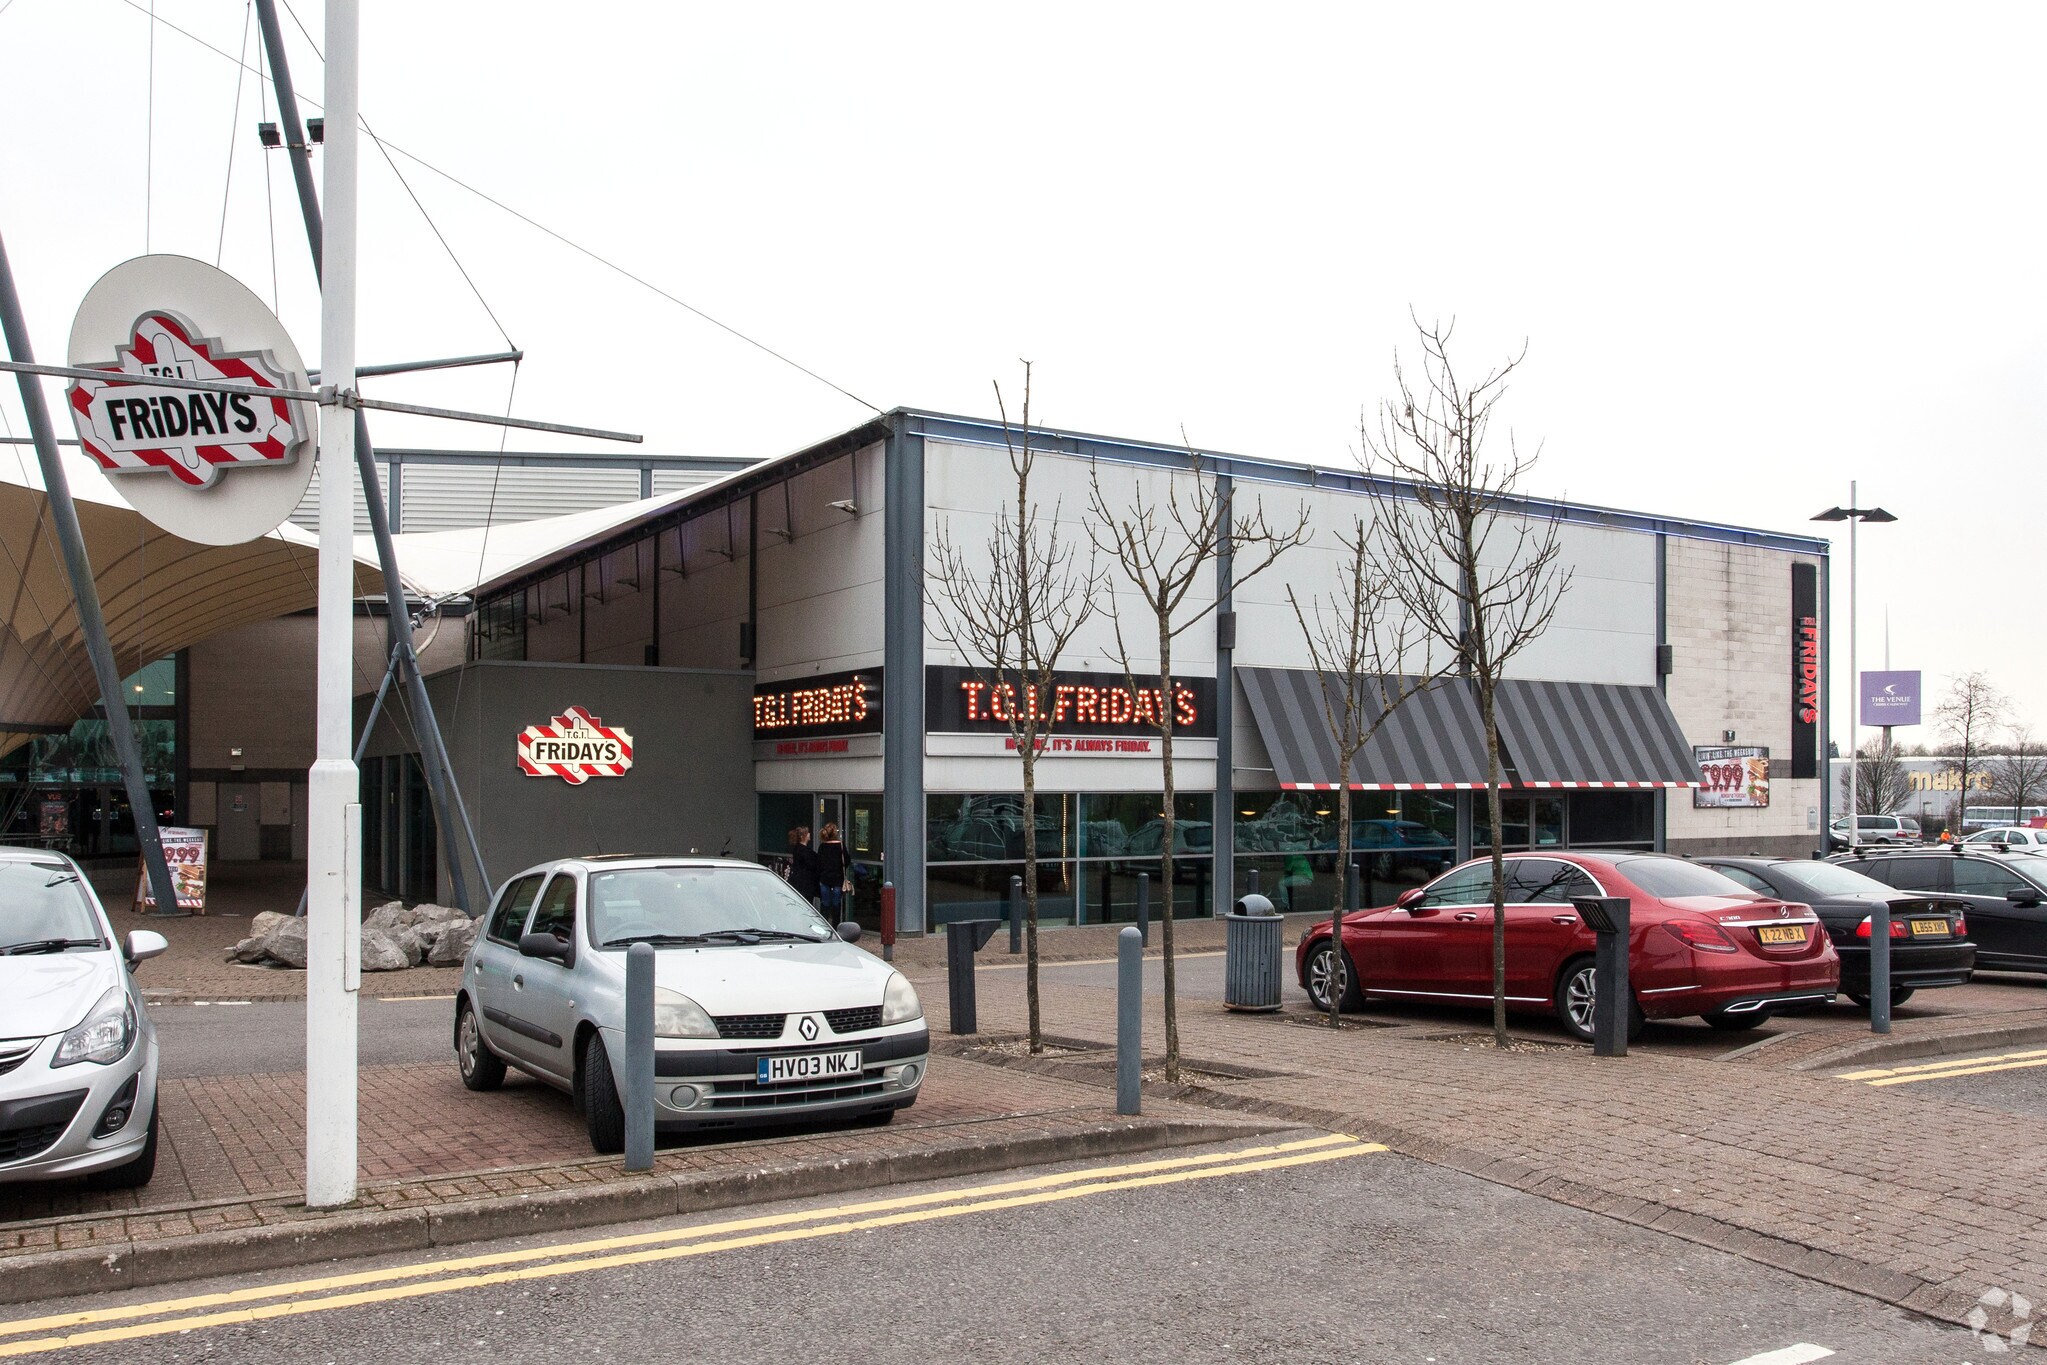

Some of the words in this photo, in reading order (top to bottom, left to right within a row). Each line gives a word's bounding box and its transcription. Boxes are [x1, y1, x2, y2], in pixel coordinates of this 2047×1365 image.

[1053, 739, 1072, 751] IT'S
[1074, 740, 1113, 752] ALWAYS
[1908, 767, 1994, 791] makro
[772, 1057, 820, 1078] HV03
[826, 1052, 859, 1073] NKJ
